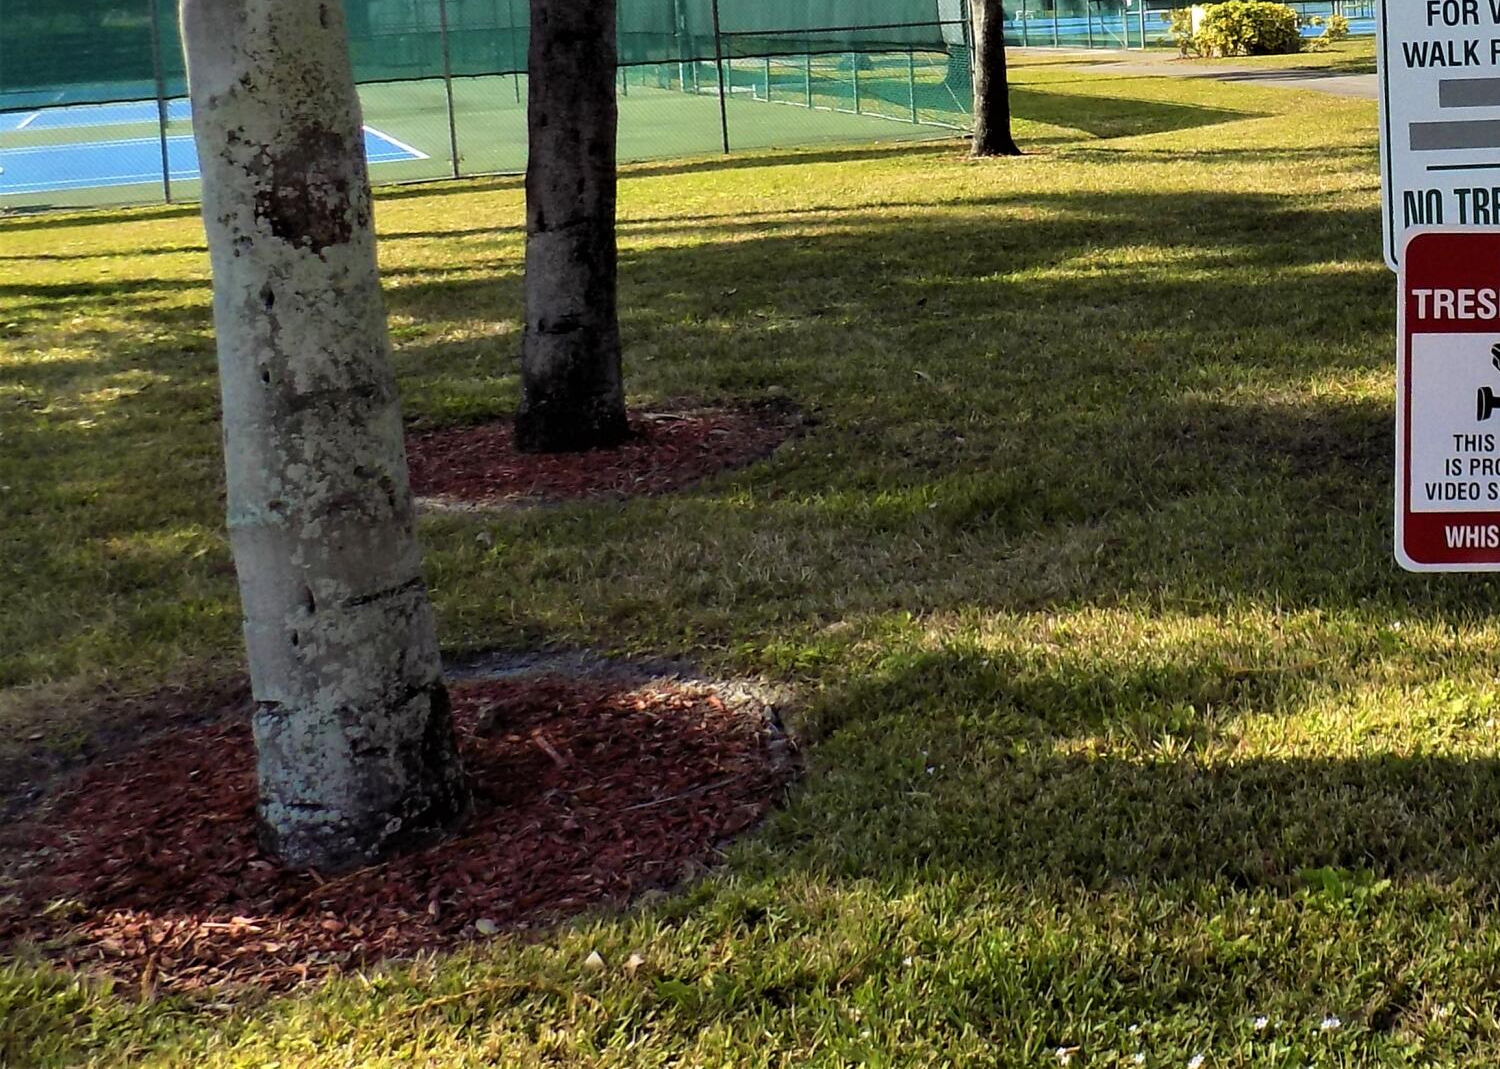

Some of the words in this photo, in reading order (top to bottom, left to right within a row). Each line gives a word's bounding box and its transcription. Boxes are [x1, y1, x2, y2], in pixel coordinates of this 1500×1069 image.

[1402, 39, 1481, 69] WALK
[1403, 189, 1443, 227] NO
[1453, 434, 1495, 452] THIS
[1445, 458, 1462, 476] IS
[1425, 482, 1480, 501] VIDEO
